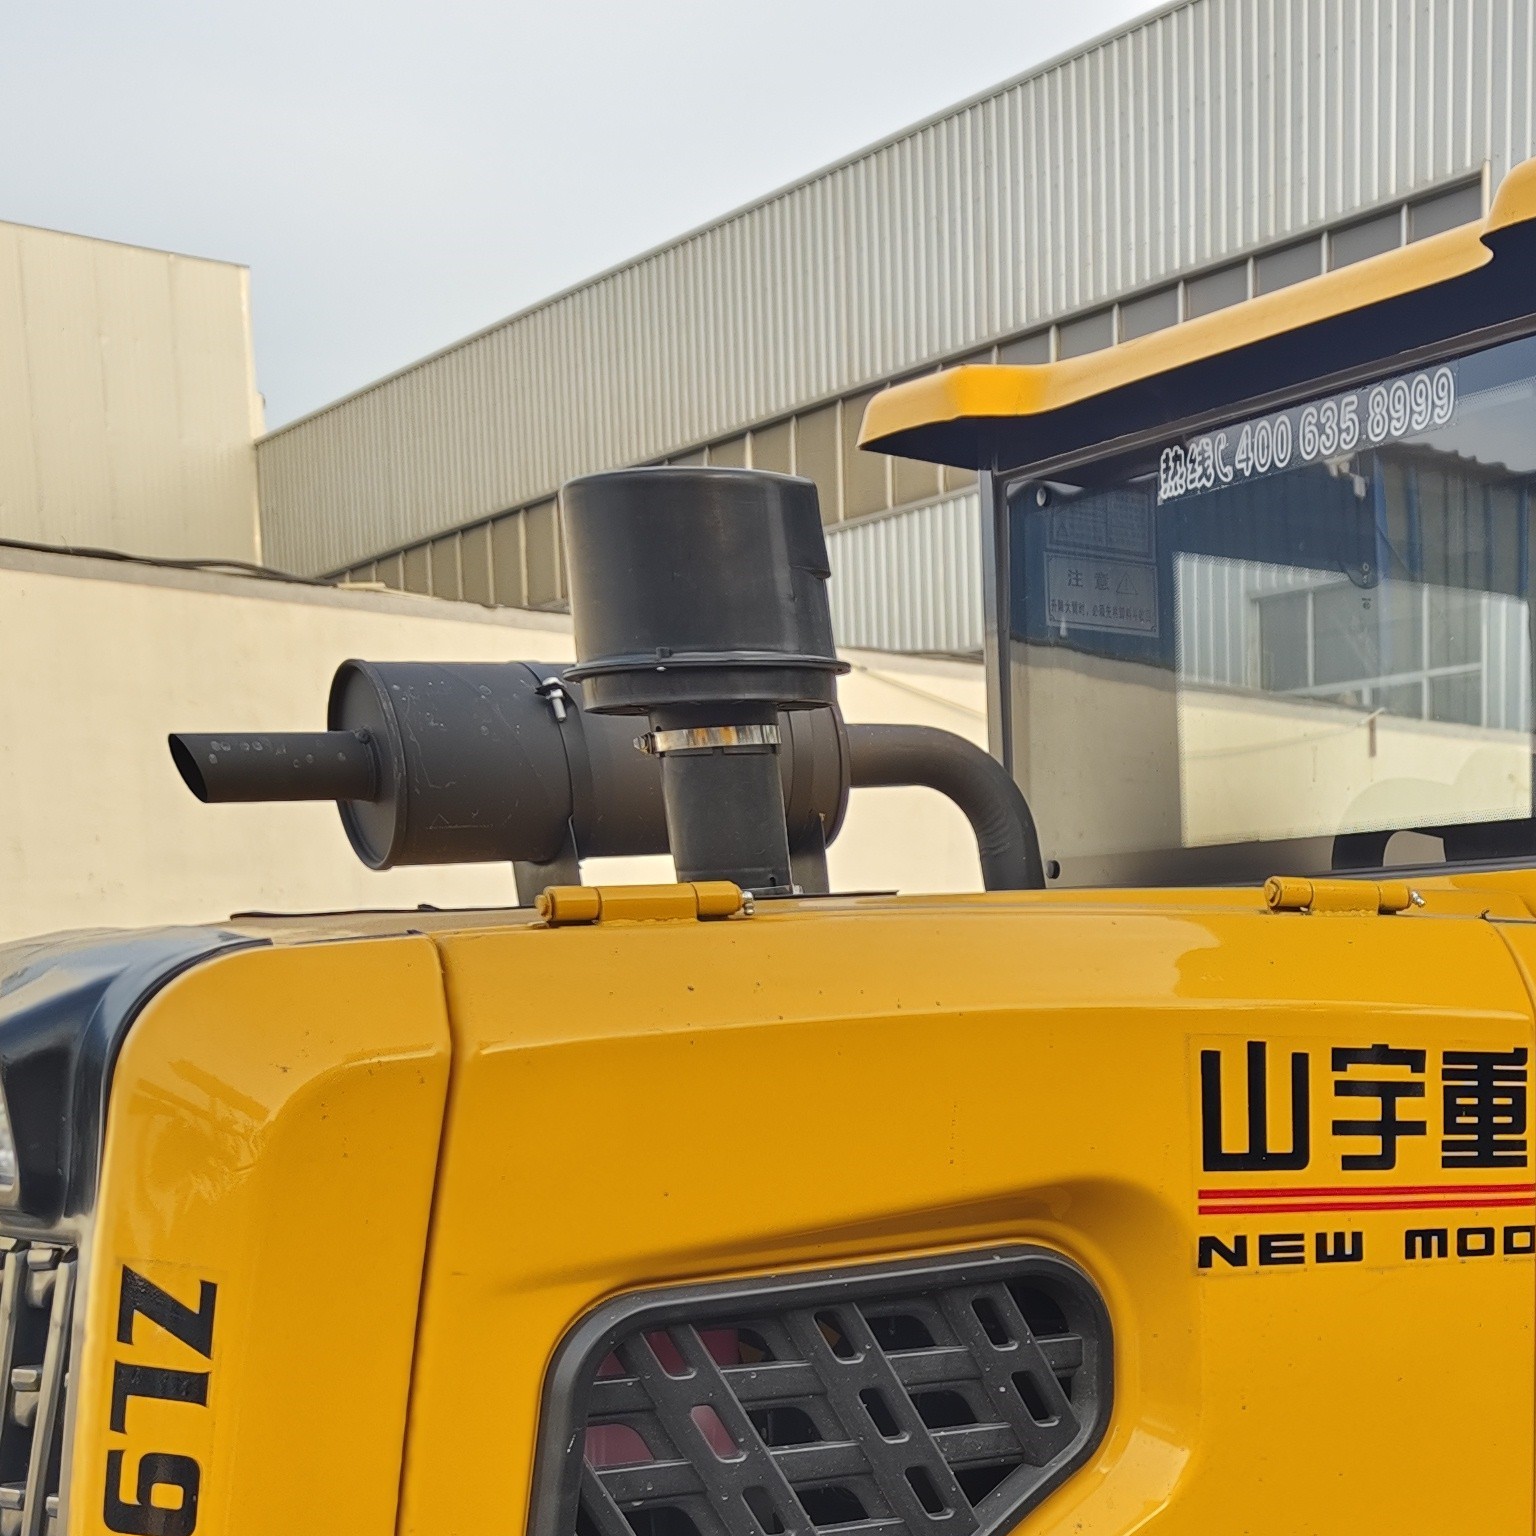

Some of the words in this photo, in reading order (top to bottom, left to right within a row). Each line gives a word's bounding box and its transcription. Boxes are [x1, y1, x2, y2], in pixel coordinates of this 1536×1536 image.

[1234, 415, 1292, 477] 400
[1299, 394, 1359, 461] 635
[1366, 366, 1455, 443] 8999
[1198, 1231, 1363, 1269] NEW
